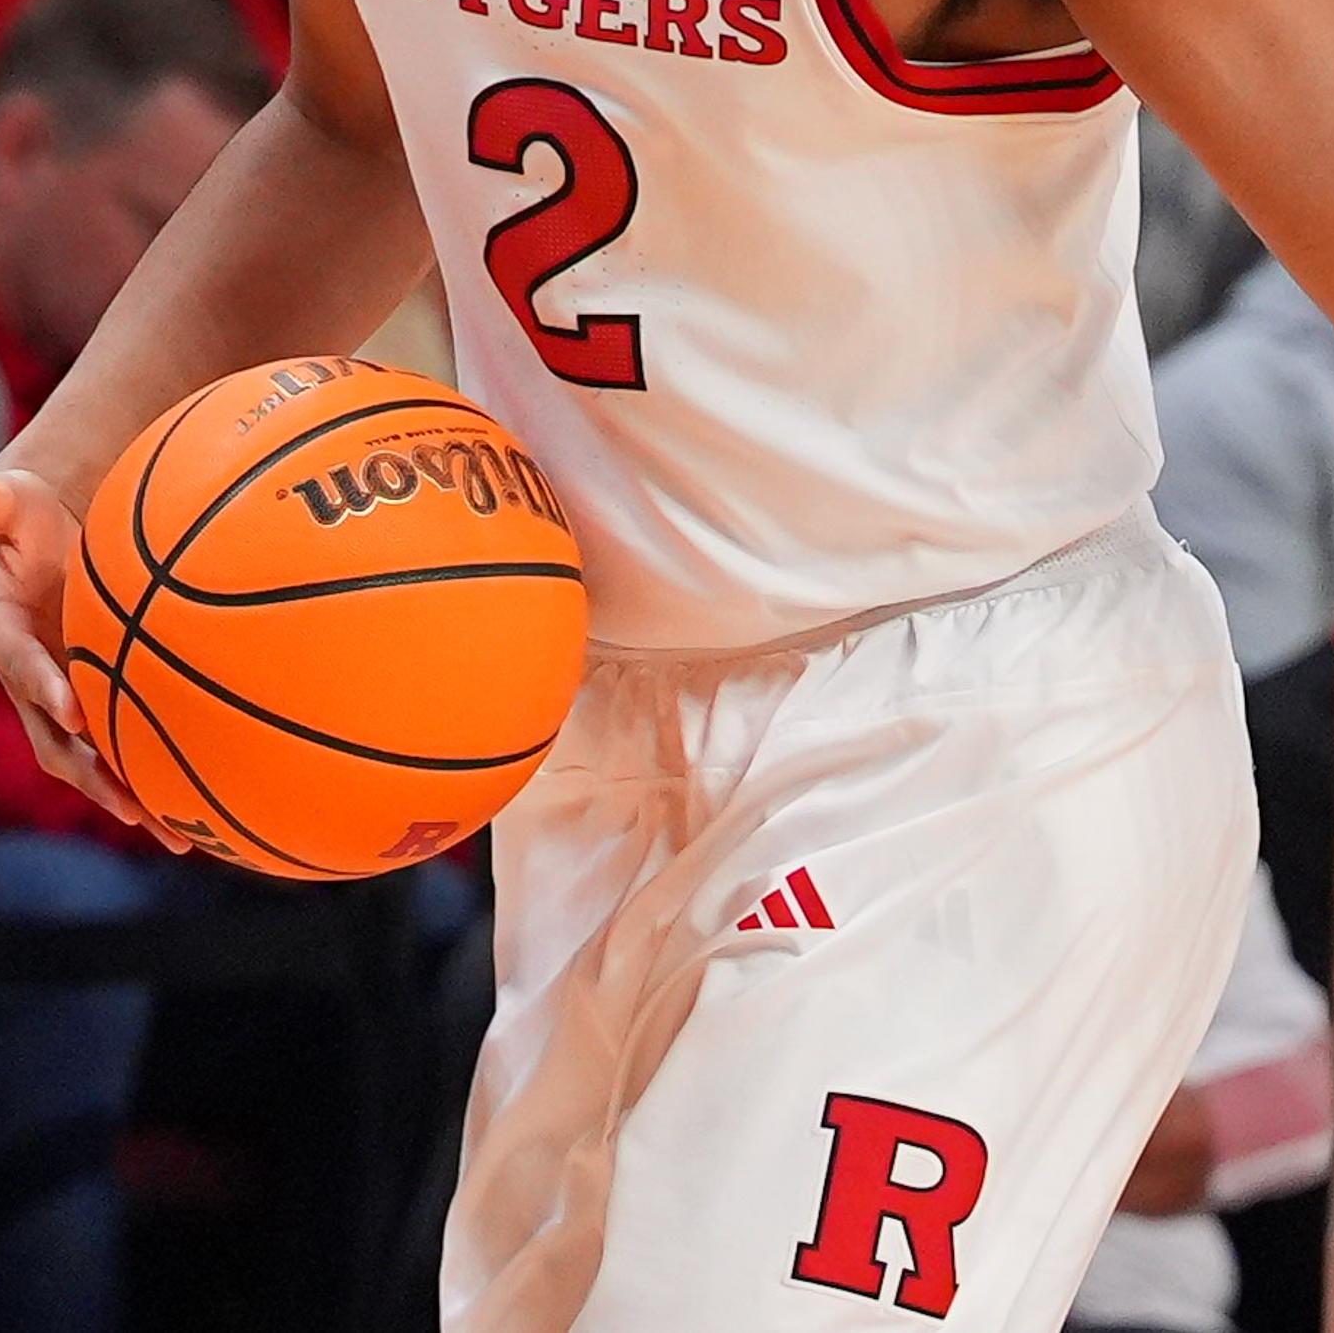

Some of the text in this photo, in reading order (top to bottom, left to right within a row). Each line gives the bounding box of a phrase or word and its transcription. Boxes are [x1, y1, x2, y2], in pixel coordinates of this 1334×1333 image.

[467, 77, 648, 391] 2
[291, 438, 573, 538] Wilson
[791, 1092, 988, 1320] R
